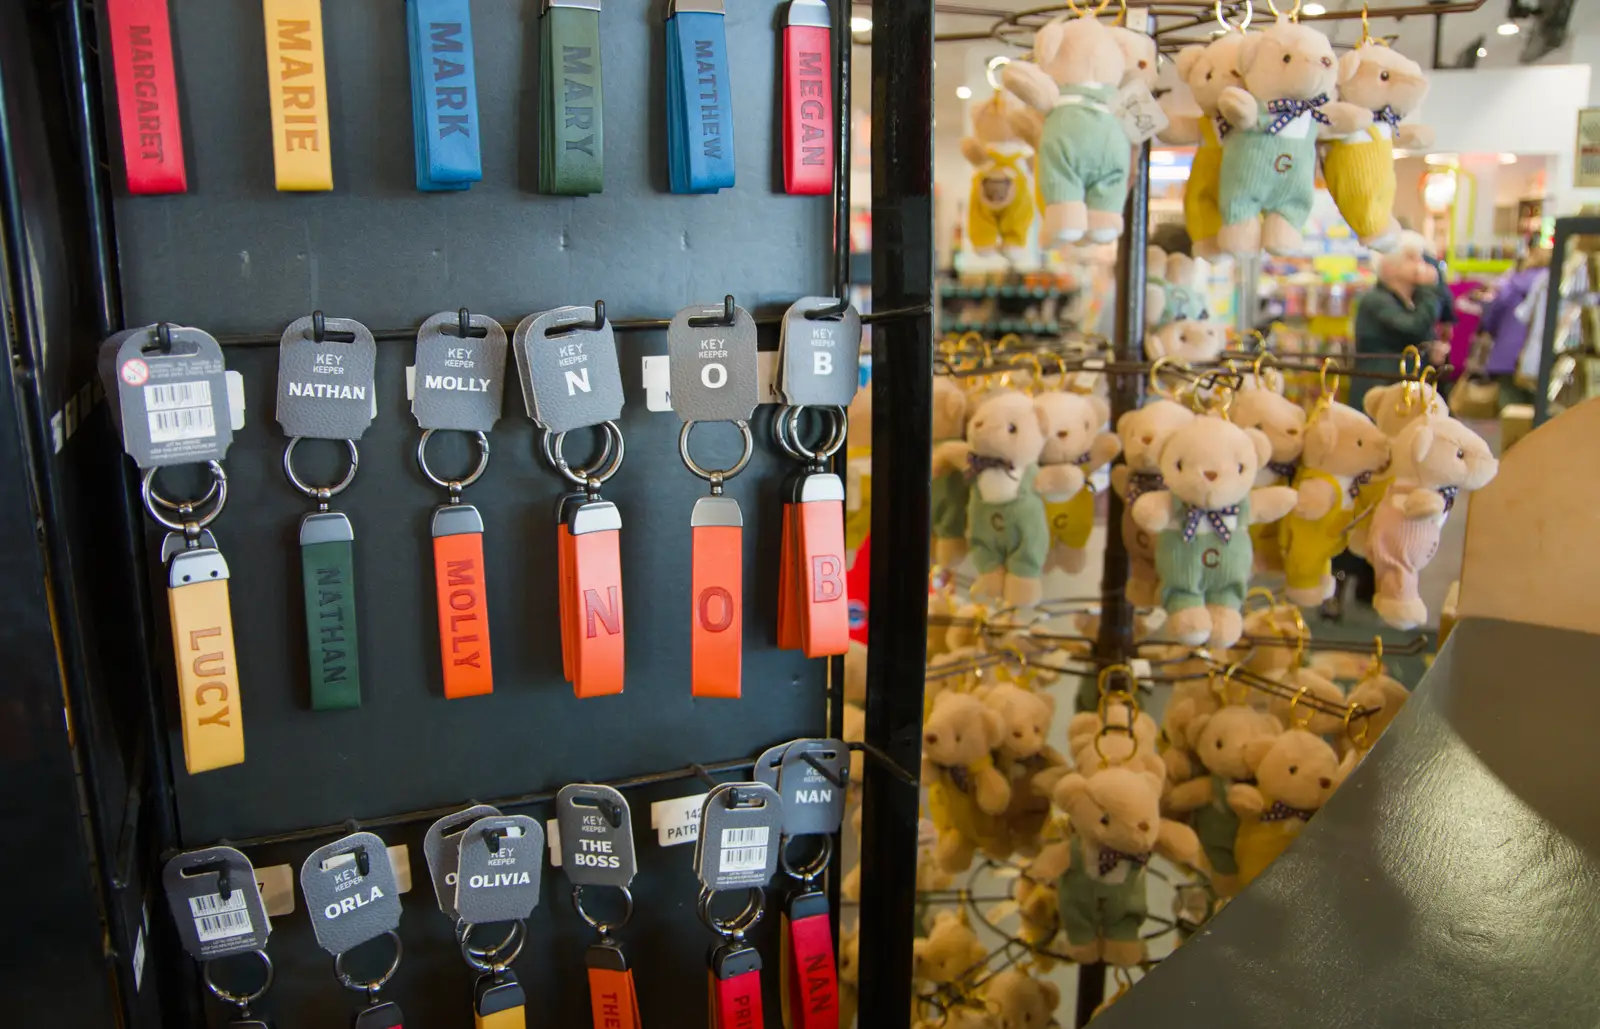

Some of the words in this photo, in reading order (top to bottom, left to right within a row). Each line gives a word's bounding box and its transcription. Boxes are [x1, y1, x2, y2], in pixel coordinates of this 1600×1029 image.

[276, 18, 321, 153] MARIE
[429, 21, 472, 141] MARK
[127, 24, 165, 164] MARGARET
[561, 44, 594, 158] MARY
[692, 39, 724, 161] MATTHEW
[798, 50, 827, 167] MEGAN
[812, 328, 834, 339] KEY
[559, 343, 584, 358] KEY
[700, 338, 726, 350] KEY
[810, 338, 836, 348] KEEPER
[316, 353, 343, 366] KEY
[447, 347, 473, 360] KEY
[558, 354, 588, 368] KEEPER
[698, 349, 729, 359] KEEPER
[313, 365, 345, 375] KEEPER
[444, 358, 475, 369] KEEPER
[813, 351, 834, 375] B
[425, 374, 491, 393] MOLLY
[564, 367, 592, 396] N
[700, 363, 728, 389] O
[288, 382, 366, 400] NATHAN
[1201, 547, 1220, 568] C
[810, 554, 844, 603] B
[447, 560, 482, 669] MOLLY
[583, 585, 621, 638] N
[696, 585, 734, 633] O
[316, 566, 347, 684] NATHAN
[189, 626, 231, 728] LUCY
[795, 789, 833, 804] NAN
[582, 815, 603, 826] KEY
[582, 825, 607, 833] KEEPER
[667, 823, 699, 840] PATR
[579, 839, 613, 853] THE
[487, 857, 516, 866] KEEPER
[575, 853, 621, 868] BOSS
[334, 867, 358, 884] KEY
[334, 875, 364, 893] KEEPER
[469, 871, 531, 889] OLIVIA
[324, 885, 385, 920] ORLA
[803, 951, 832, 1015] NAN
[601, 992, 620, 1029] THE
[734, 993, 754, 1029] PRI
